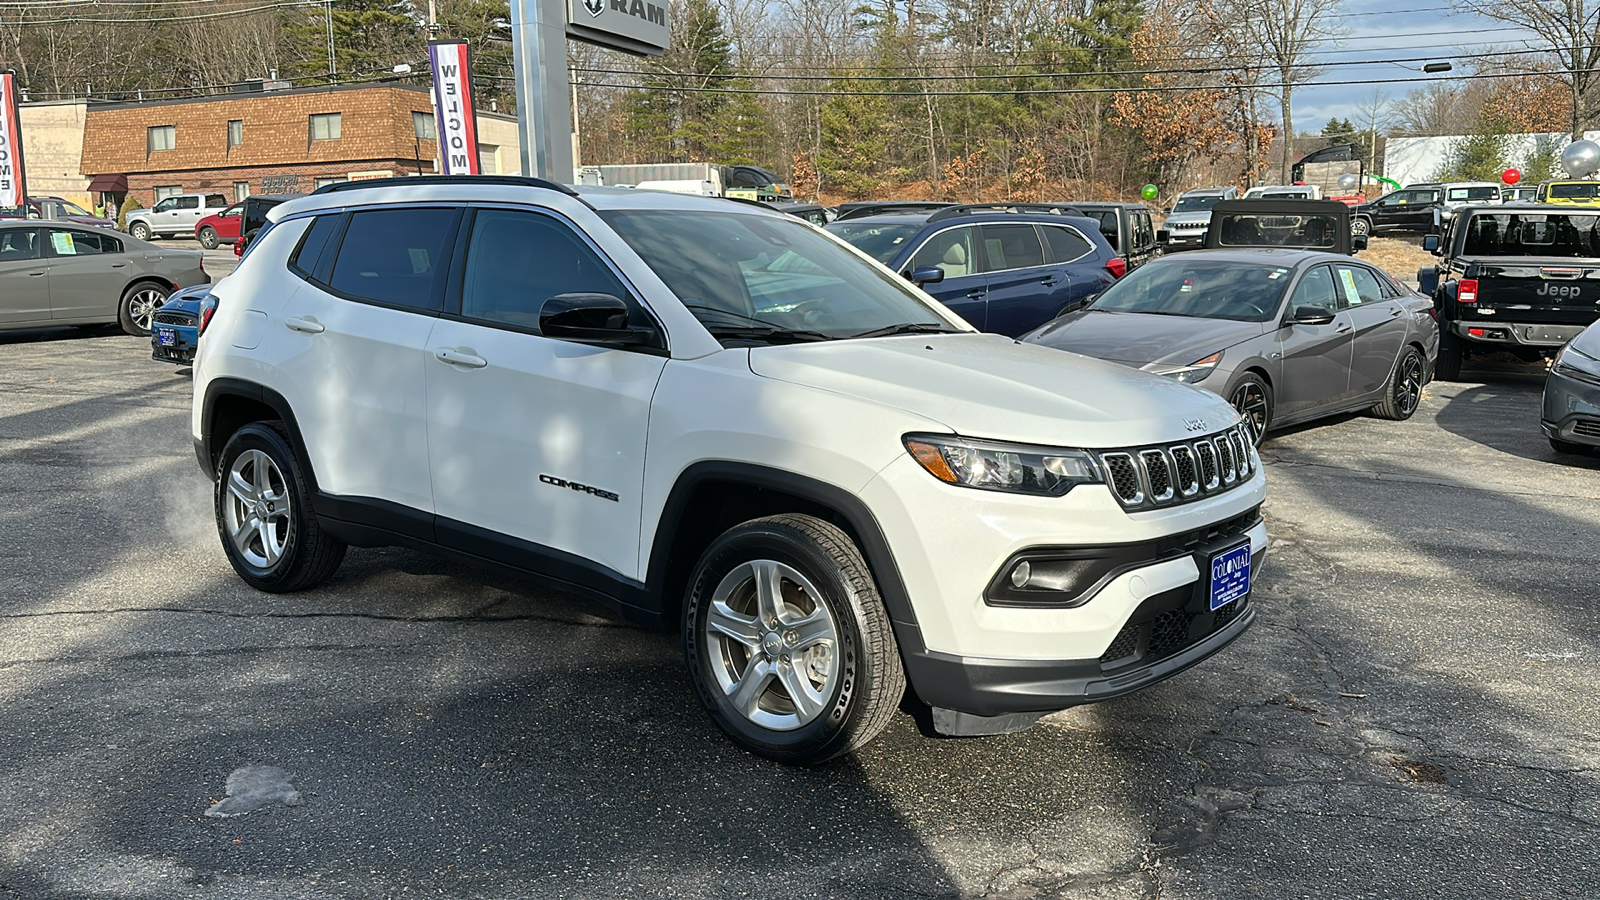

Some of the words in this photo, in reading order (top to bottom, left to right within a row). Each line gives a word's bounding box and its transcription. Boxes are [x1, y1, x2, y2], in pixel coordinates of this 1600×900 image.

[610, 0, 665, 26] RAM
[1536, 282, 1581, 298] Jeep
[539, 474, 619, 502] COMPASS
[1212, 552, 1250, 581] COLONIAL
